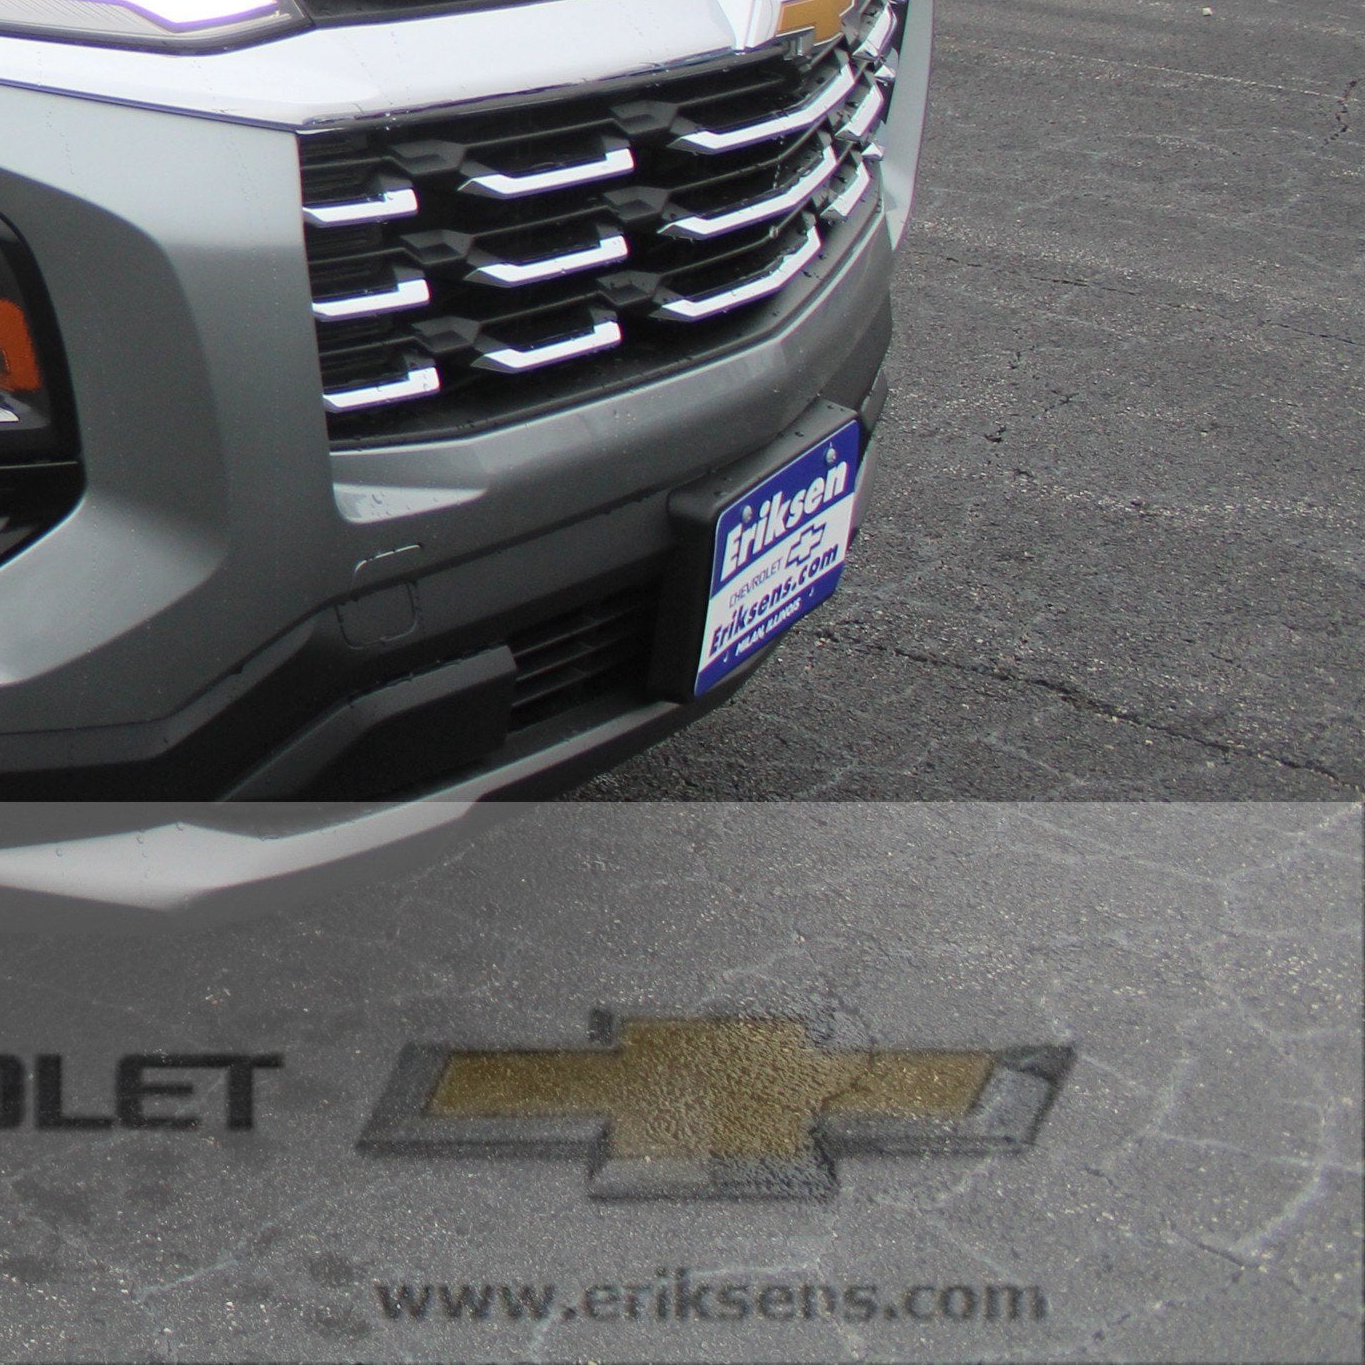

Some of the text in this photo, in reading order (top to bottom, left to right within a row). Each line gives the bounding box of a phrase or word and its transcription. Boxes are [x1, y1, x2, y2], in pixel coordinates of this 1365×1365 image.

[720, 460, 848, 582] Eriksen
[709, 543, 839, 658] Eriksens.com
[729, 555, 784, 609] CHEVROLET
